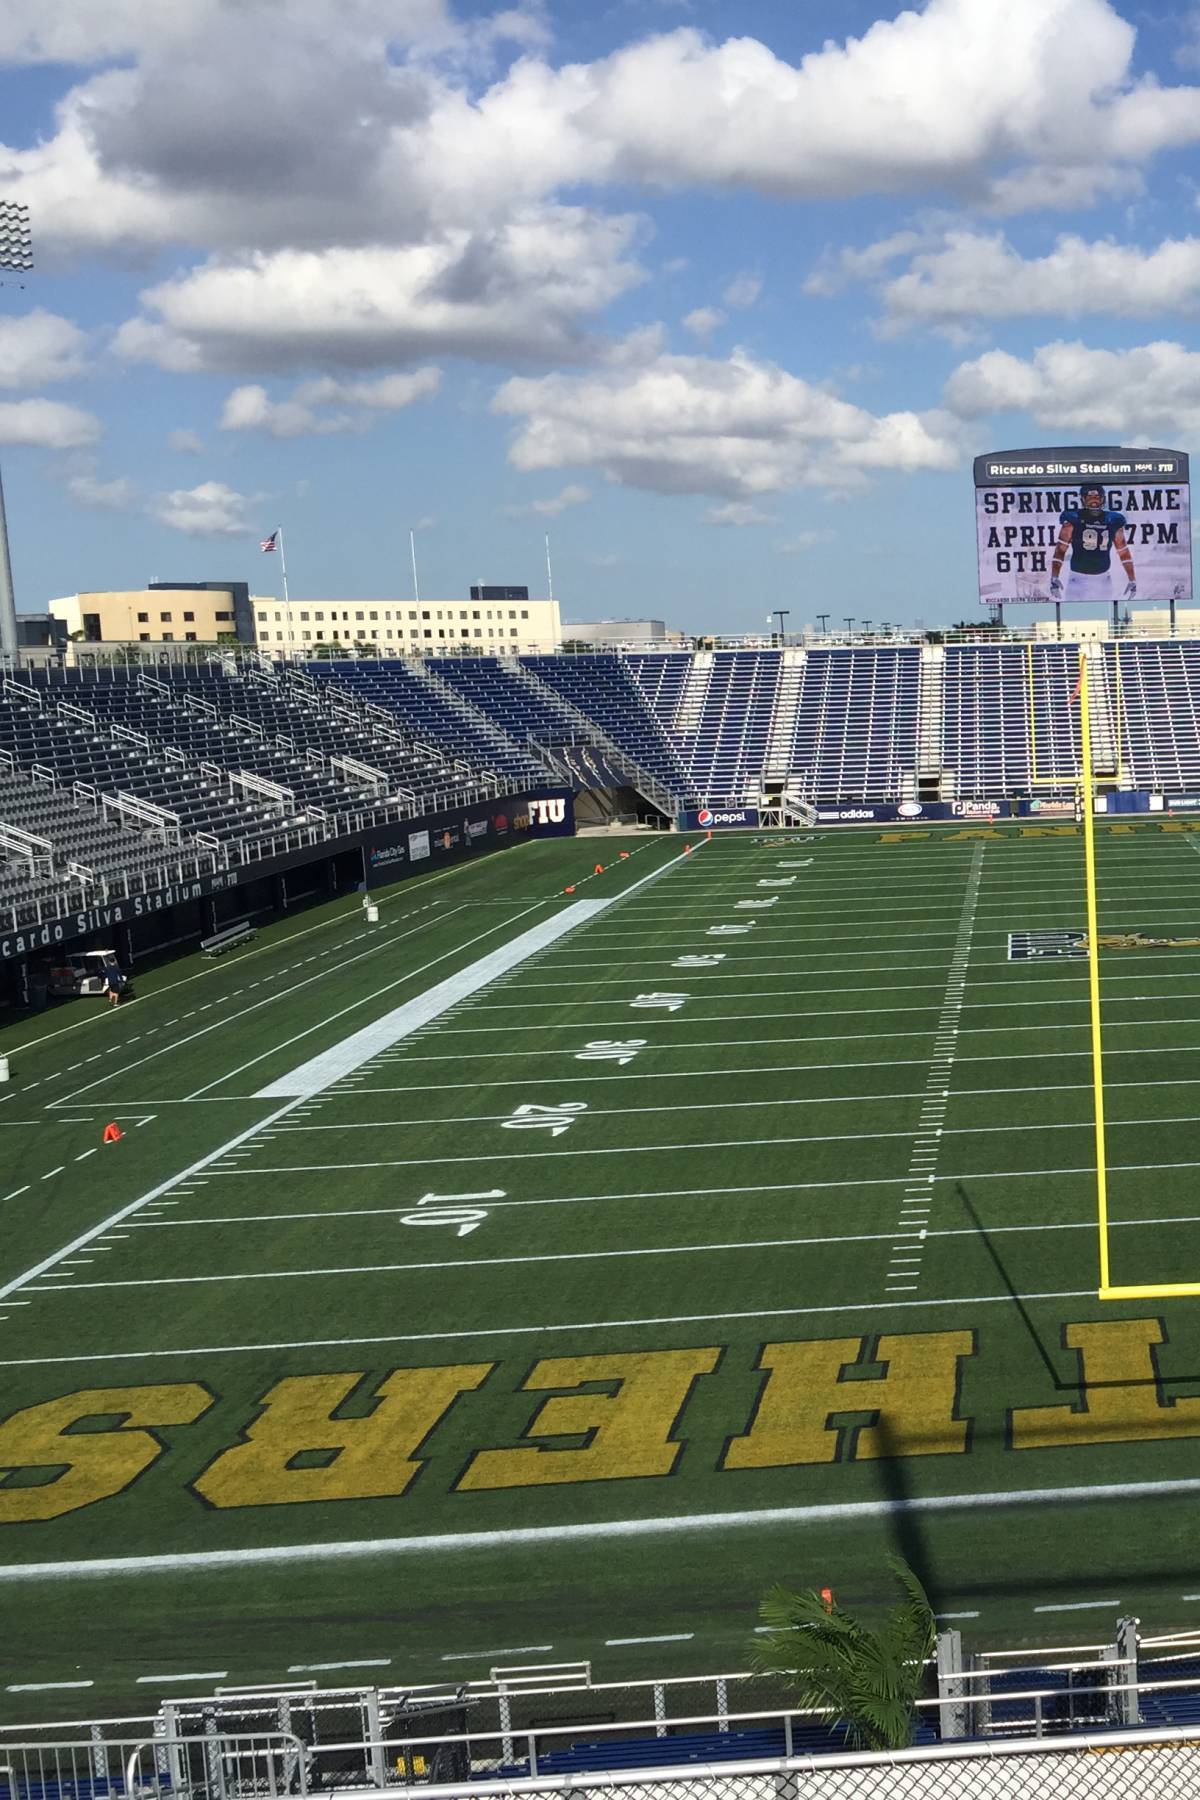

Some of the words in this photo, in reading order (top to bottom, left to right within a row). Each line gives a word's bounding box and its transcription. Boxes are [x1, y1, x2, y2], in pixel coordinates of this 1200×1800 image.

[990, 464, 1044, 475] Riccardo
[1046, 463, 1077, 474] Silva
[1080, 462, 1131, 473] Stadium
[1158, 464, 1173, 472] FIU
[984, 491, 1079, 514] SPRING
[1108, 489, 1180, 511] GAME
[987, 526, 1059, 548] APRIL
[1125, 523, 1179, 545] 7PM
[1082, 528, 1109, 551] 91
[997, 551, 1047, 573] 6TH
[528, 799, 565, 825] FIU
[714, 811, 746, 824] pepsi
[840, 809, 875, 819] adidas
[967, 801, 997, 811] Panda
[78, 906, 122, 933] Silva
[135, 883, 201, 915] Stadium
[574, 1039, 648, 1060] 30
[500, 1102, 588, 1129] 20
[400, 1189, 507, 1226] 10
